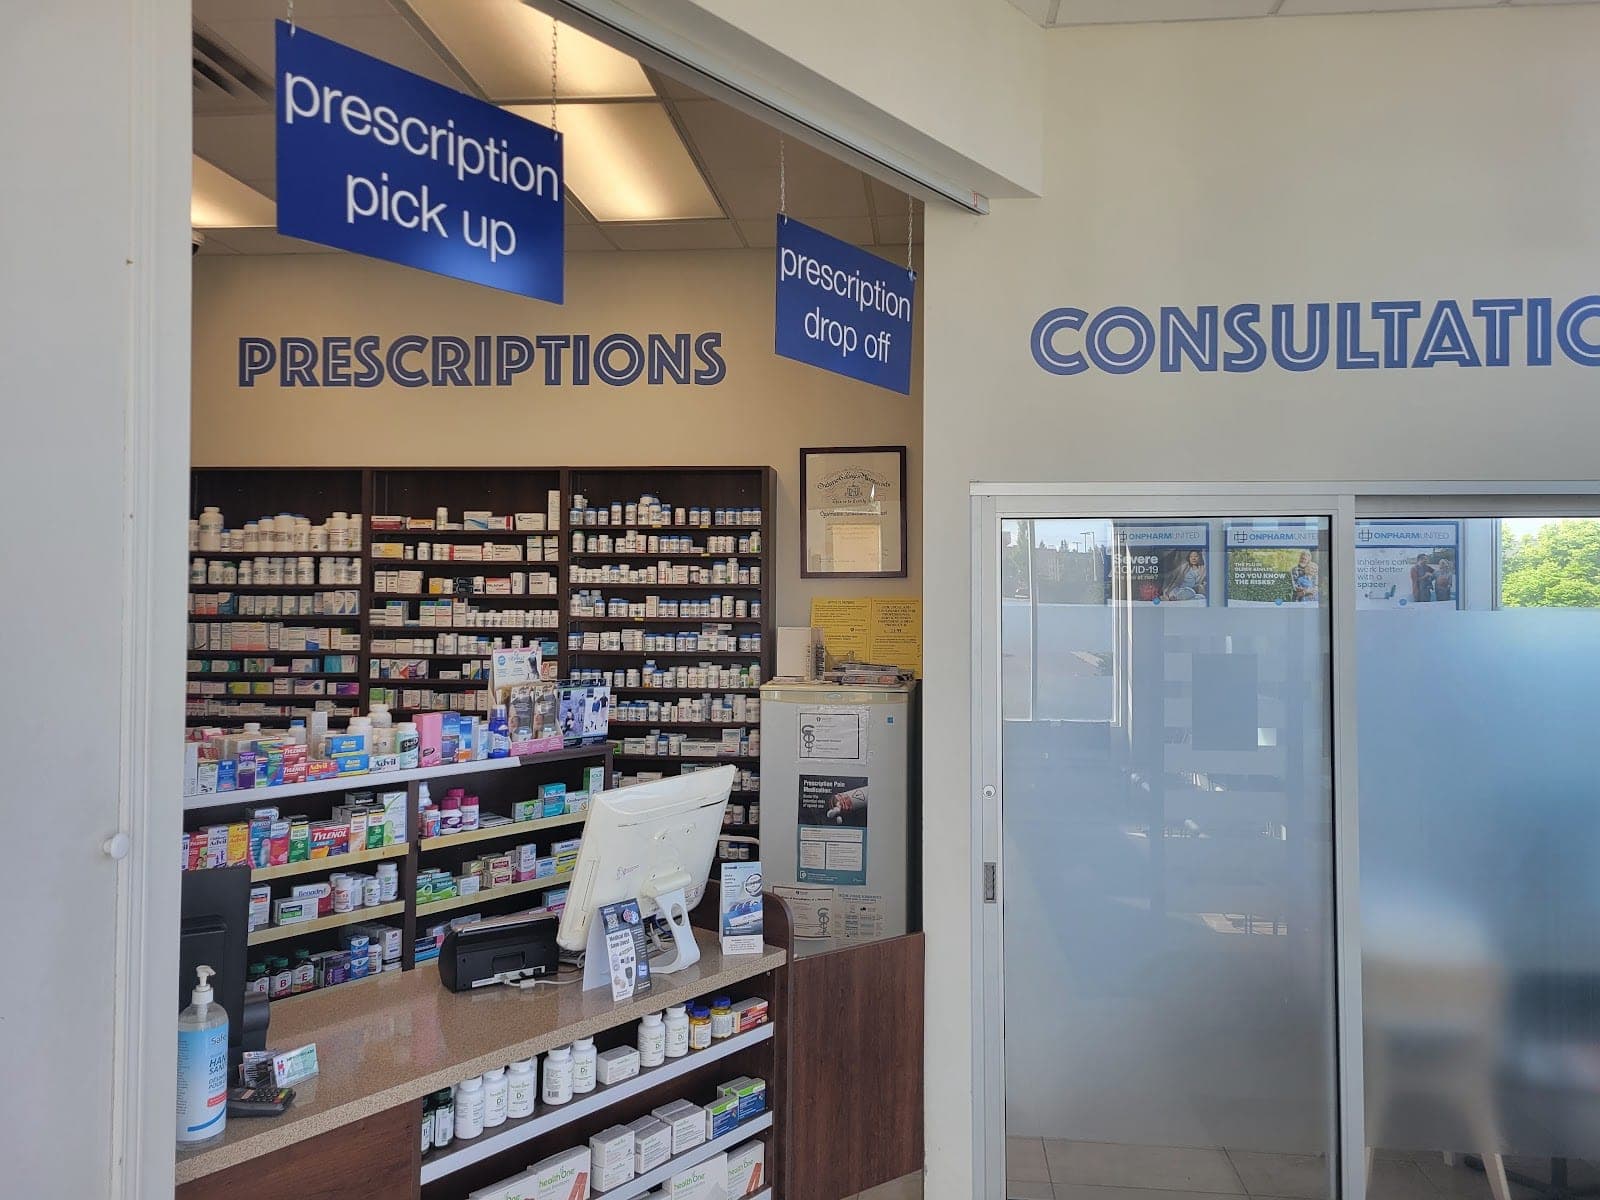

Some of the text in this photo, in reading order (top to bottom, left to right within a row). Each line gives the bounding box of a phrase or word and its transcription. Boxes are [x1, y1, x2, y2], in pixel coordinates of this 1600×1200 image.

[284, 71, 560, 202] prescription
[345, 173, 518, 262] pick up
[780, 245, 911, 323] prescription
[803, 306, 892, 364] drop off
[1030, 294, 1600, 375] CONSULTATIO
[239, 332, 727, 387] PRESCRIPTIONS
[1128, 531, 1200, 540] ONPHARMUNITED
[1373, 532, 1450, 540] ONPHARMUNITED
[1378, 566, 1403, 574] better
[1357, 581, 1386, 590] spacer
[375, 758, 397, 767] Advil
[312, 829, 347, 842] TYLENOL
[298, 887, 327, 898] Benadryl
